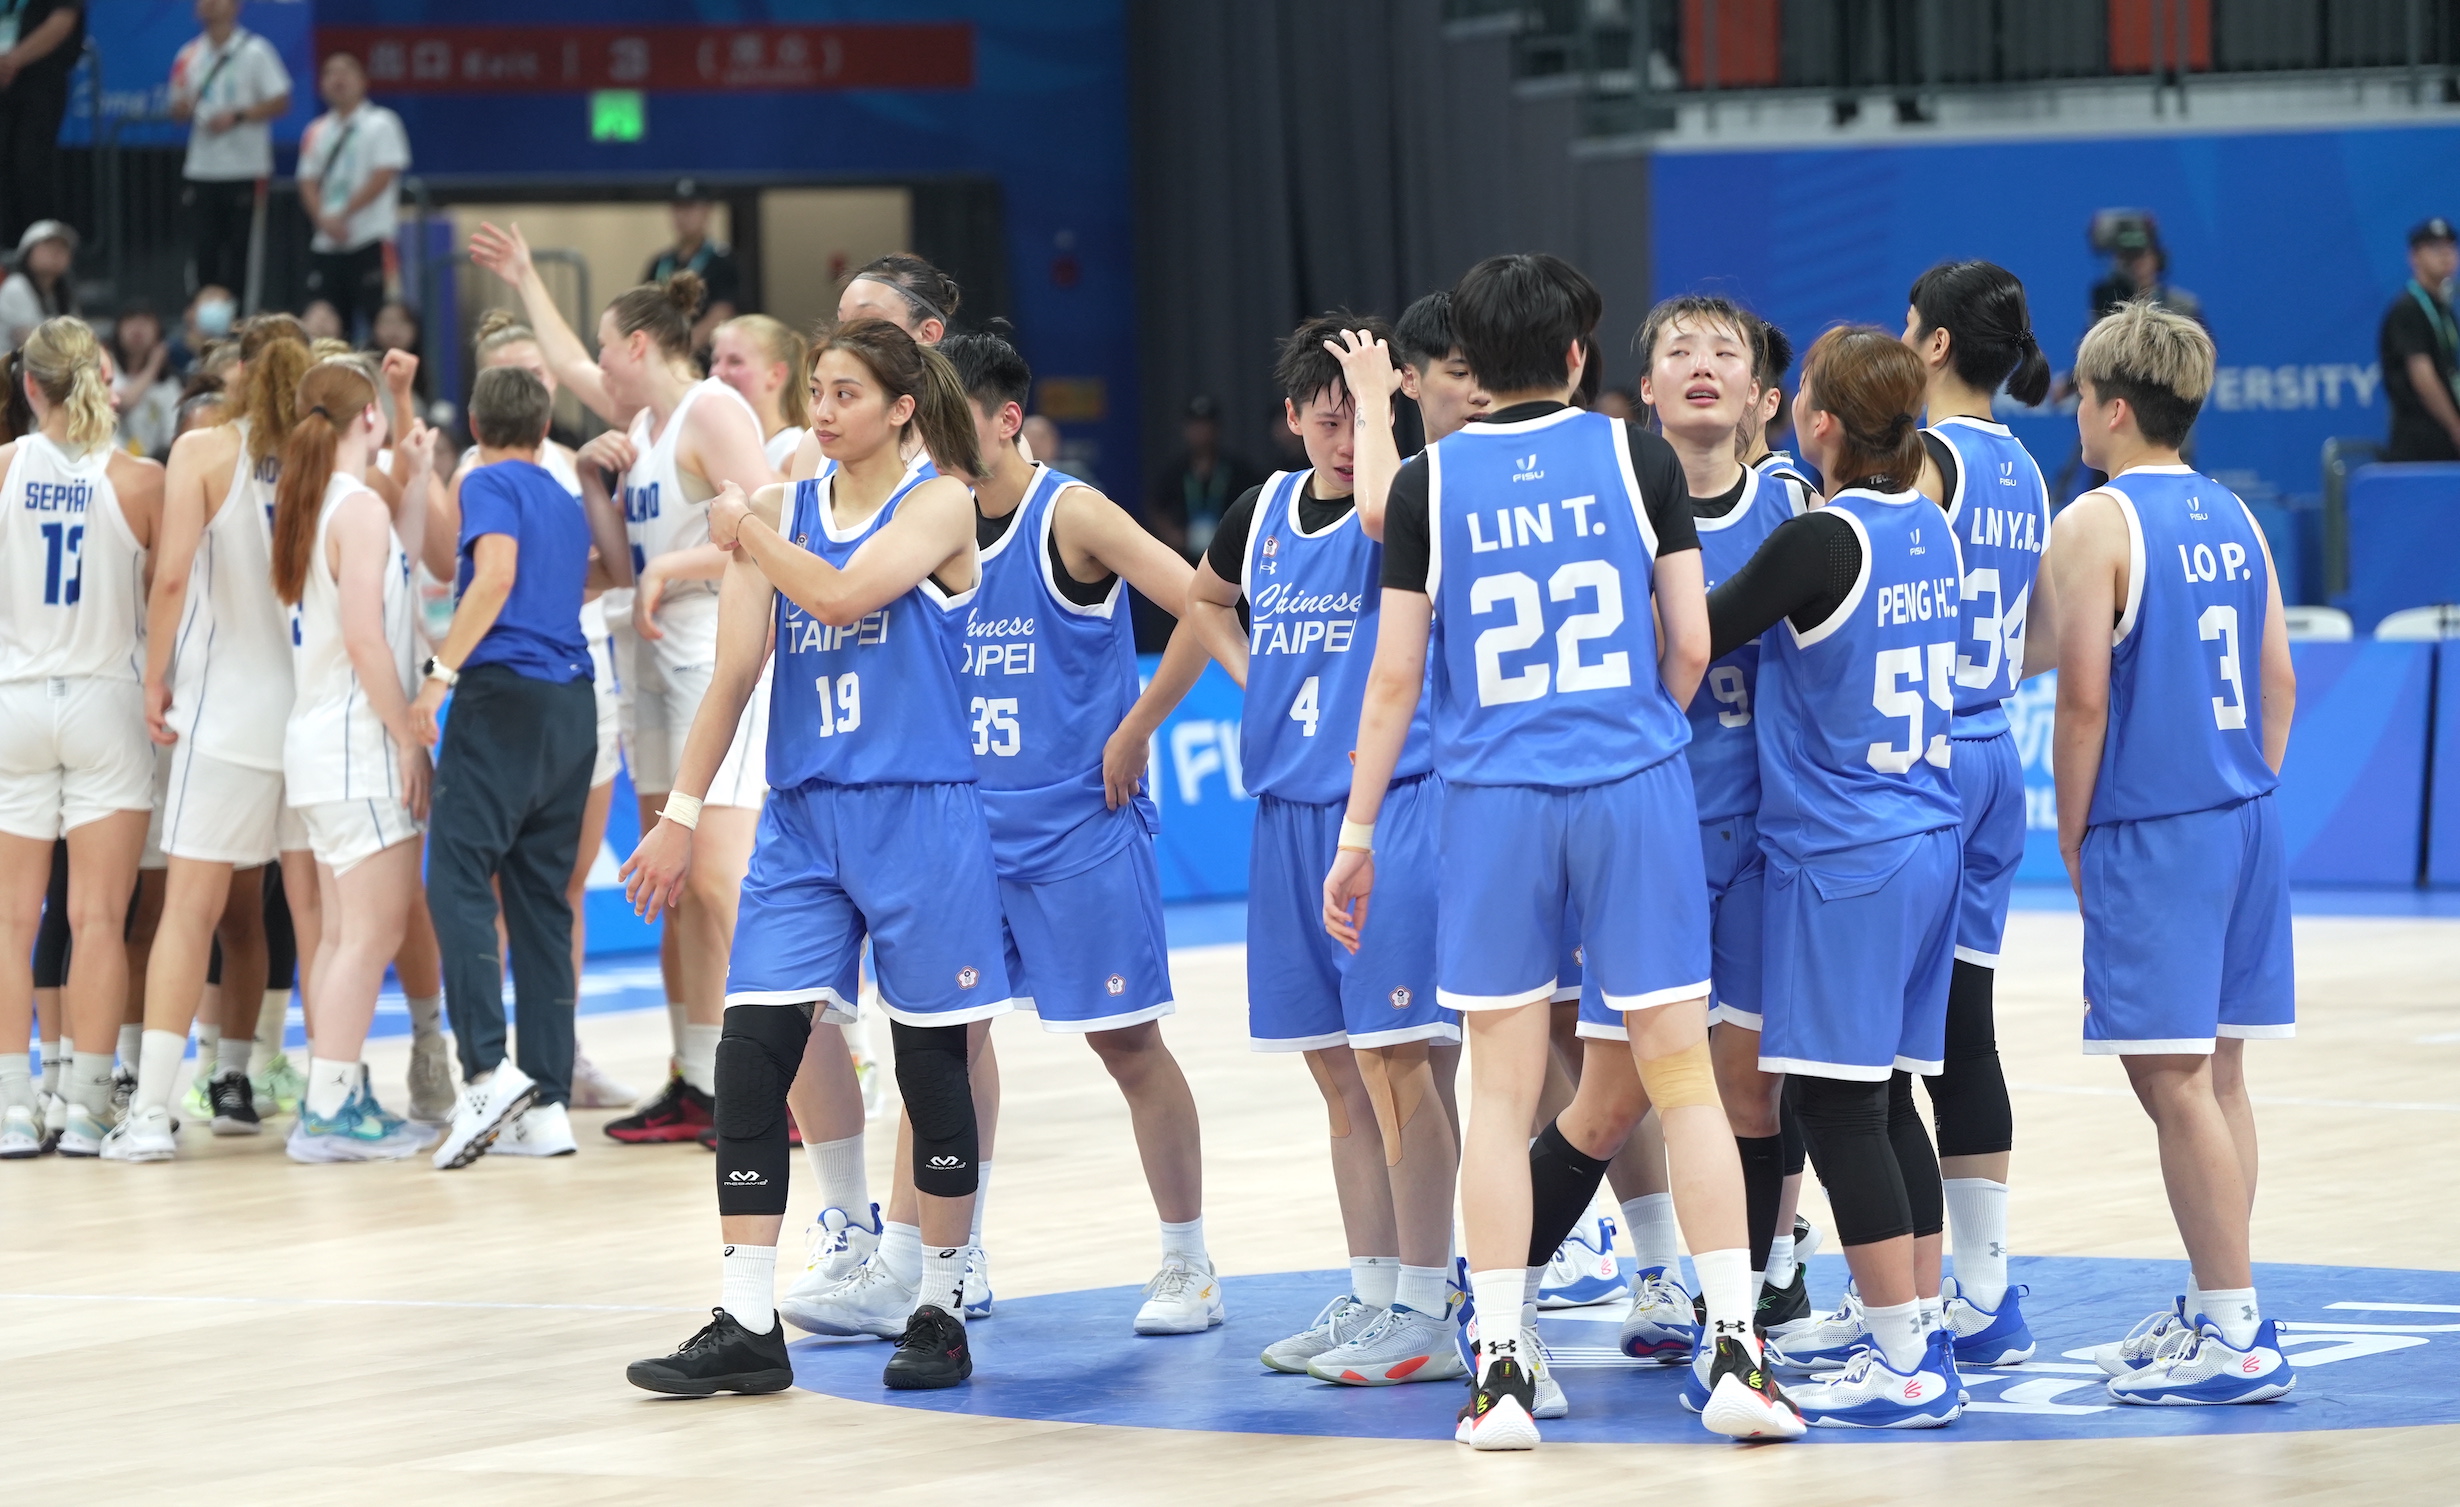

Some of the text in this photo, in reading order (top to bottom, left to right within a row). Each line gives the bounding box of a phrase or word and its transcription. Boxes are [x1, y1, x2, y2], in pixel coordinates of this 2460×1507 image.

[2200, 365, 2384, 411] ERSITY
[1512, 469, 1545, 483] FISU
[1466, 494, 1606, 554] LIN T.
[2178, 542, 2252, 583] LO P.
[785, 609, 890, 654] TAIPEI
[1253, 582, 1363, 623] Chinese
[1877, 579, 1932, 628] PENG
[1954, 568, 2029, 691] 34
[1469, 559, 1631, 708] 22
[1707, 665, 1752, 729] 9
[2198, 605, 2247, 731] 3
[815, 670, 861, 738] 19
[970, 696, 1021, 757] 35
[1288, 675, 1320, 738] 4
[1866, 641, 1956, 775] 55
